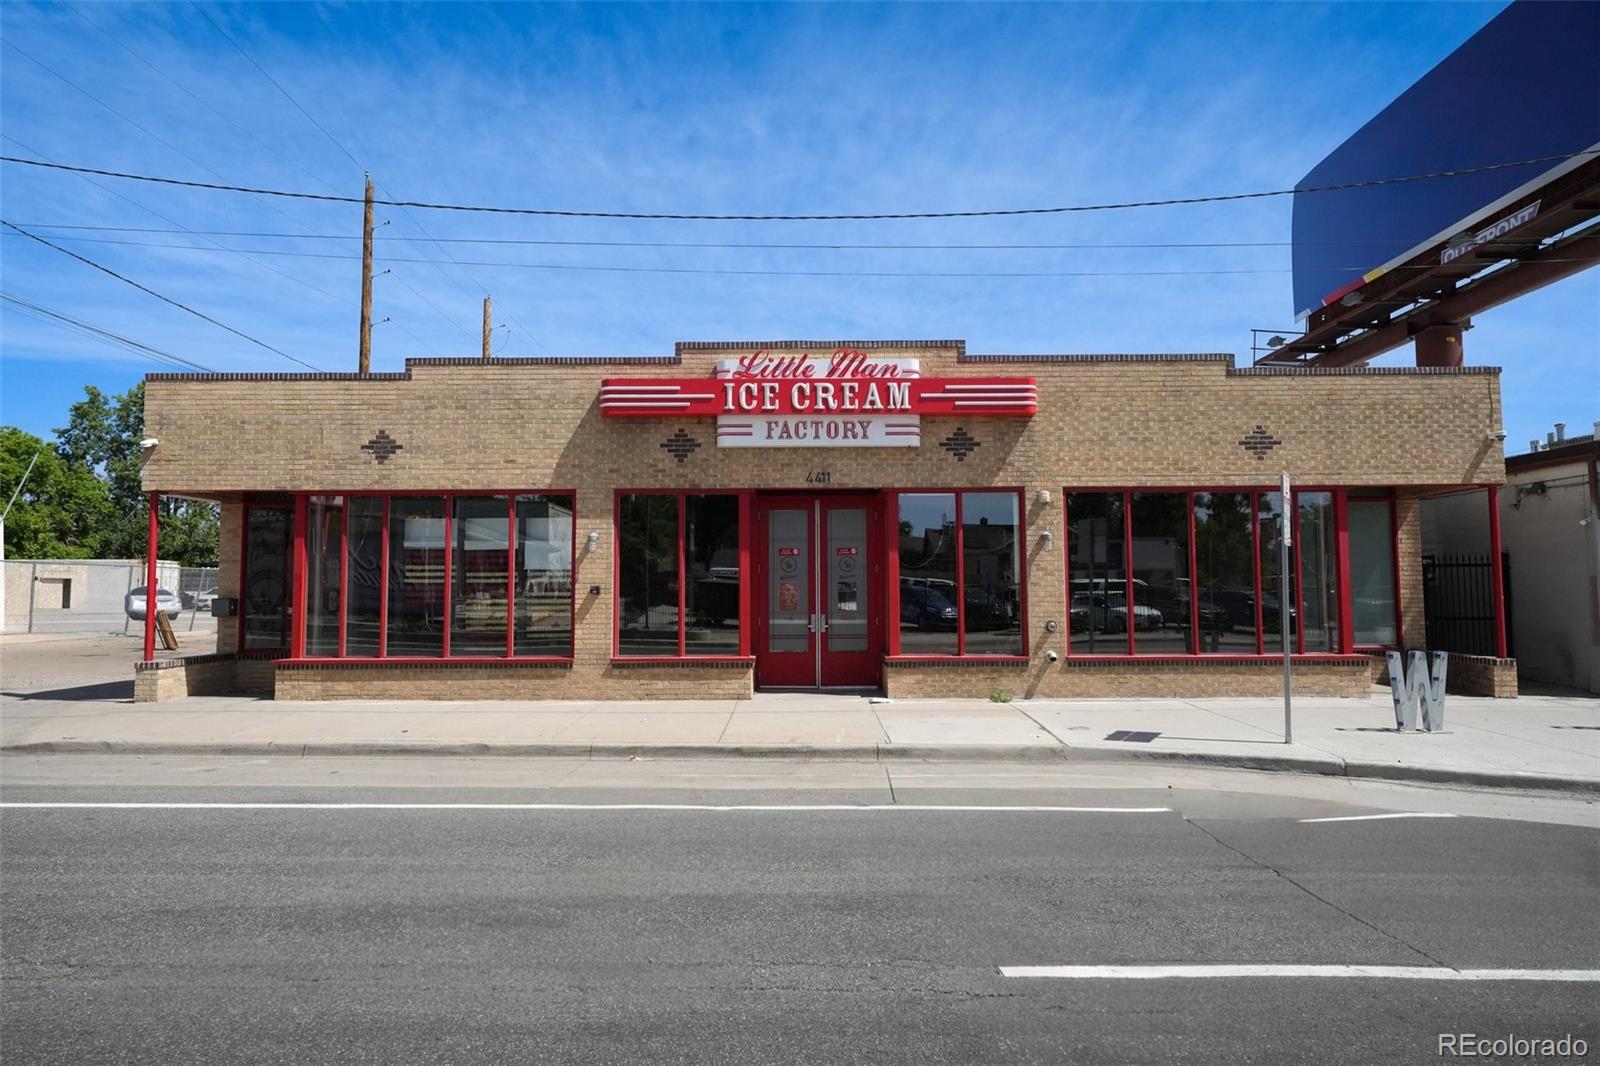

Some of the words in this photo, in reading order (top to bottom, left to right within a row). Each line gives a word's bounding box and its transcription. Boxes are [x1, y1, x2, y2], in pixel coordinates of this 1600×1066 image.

[1443, 206, 1535, 264] OUFRONT
[732, 349, 816, 379] Little
[825, 347, 900, 378] Man
[724, 382, 779, 410] ICE
[791, 382, 911, 410] CREAM
[765, 420, 872, 440] FACTORY
[806, 471, 831, 483] 4411
